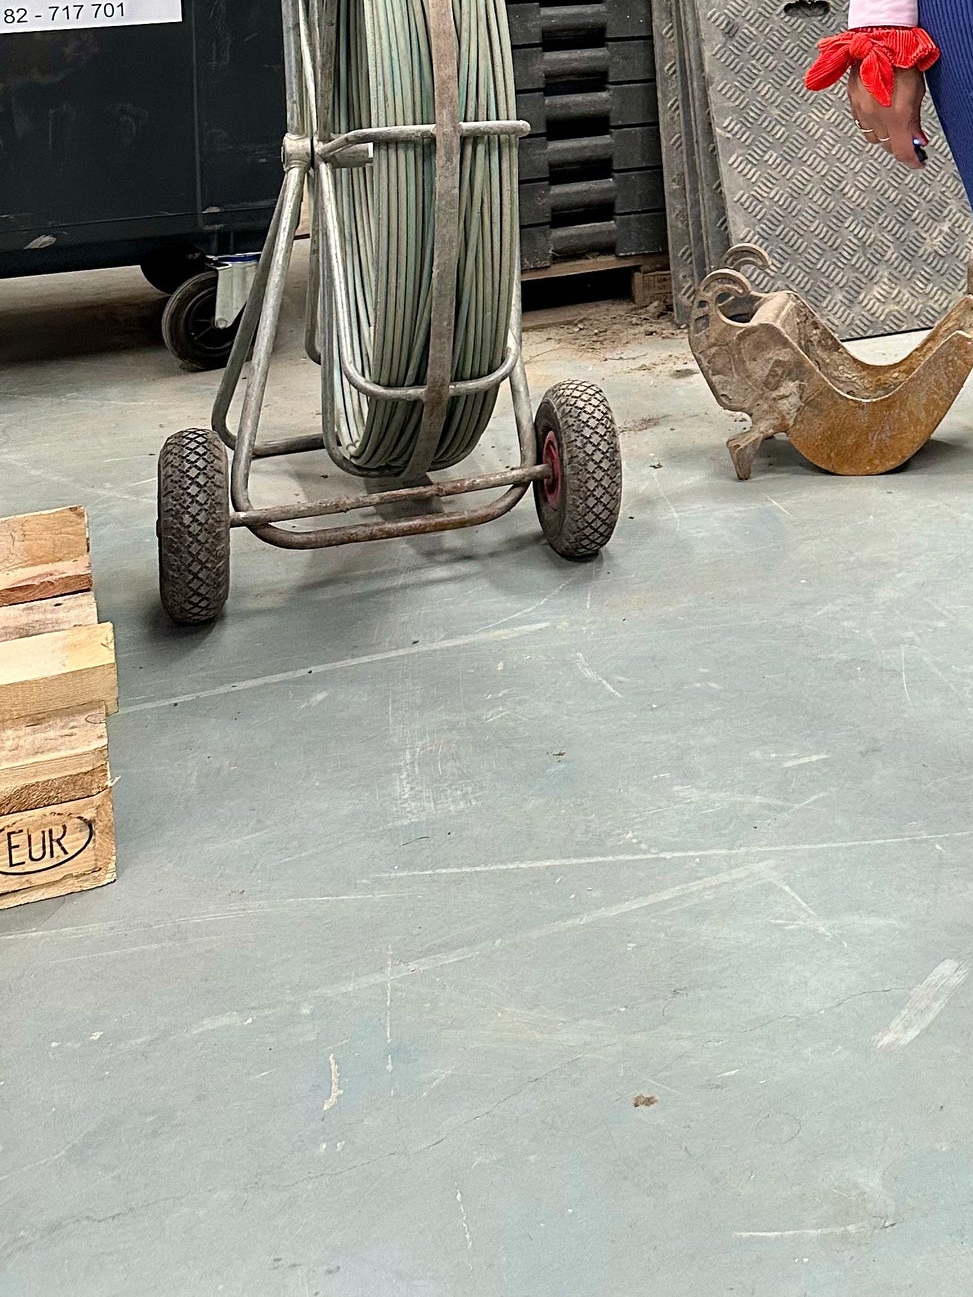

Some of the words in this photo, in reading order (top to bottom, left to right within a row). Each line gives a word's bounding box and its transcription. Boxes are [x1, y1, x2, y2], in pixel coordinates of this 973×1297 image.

[3, 7, 28, 24] 82
[48, 4, 84, 21] 717
[91, 2, 126, 19] 701
[7, 824, 69, 867] EUR
